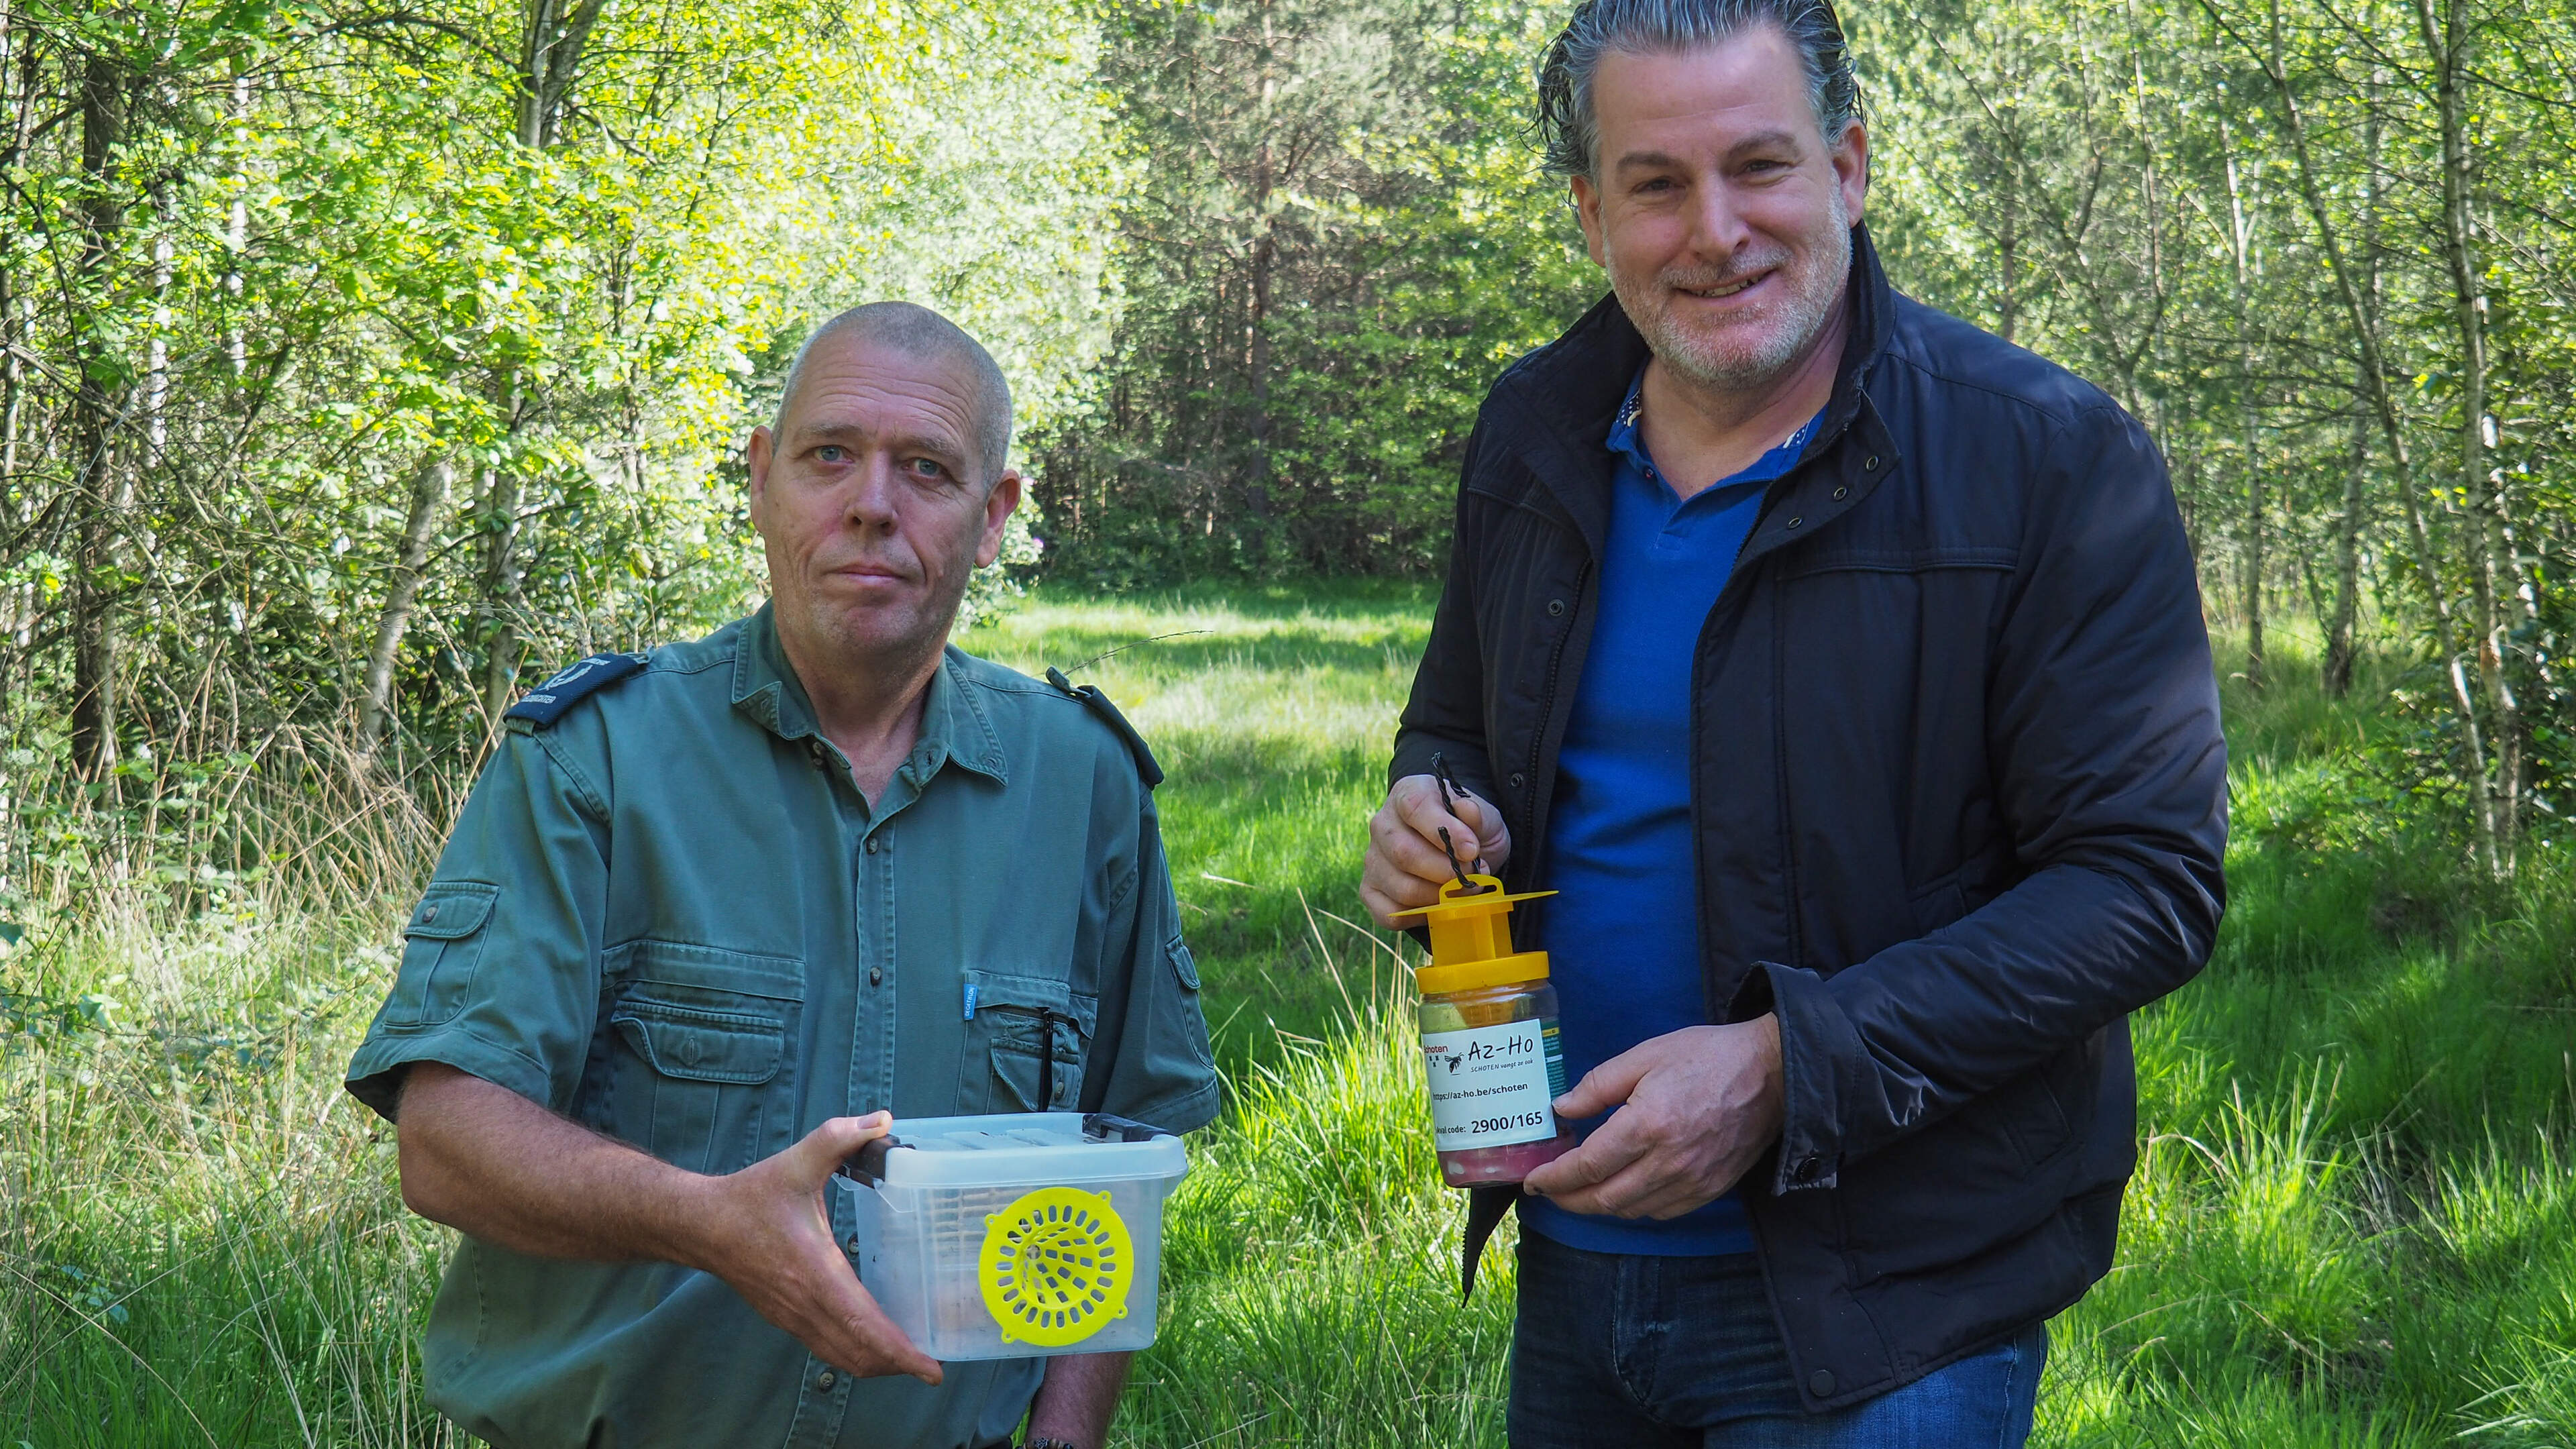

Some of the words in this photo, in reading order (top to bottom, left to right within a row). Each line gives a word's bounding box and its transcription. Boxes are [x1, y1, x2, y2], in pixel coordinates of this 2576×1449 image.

[965, 987, 975, 1016] DECATHLON
[1468, 1034, 1534, 1061] Az-Ho
[1470, 1063, 1499, 1073] SCHOTEN
[1501, 1061, 1516, 1069] vangt
[1433, 1083, 1528, 1102] https://az-ho.be/schoten
[1448, 1126, 1466, 1134] code:
[1470, 1111, 1543, 1134] 2900/165
